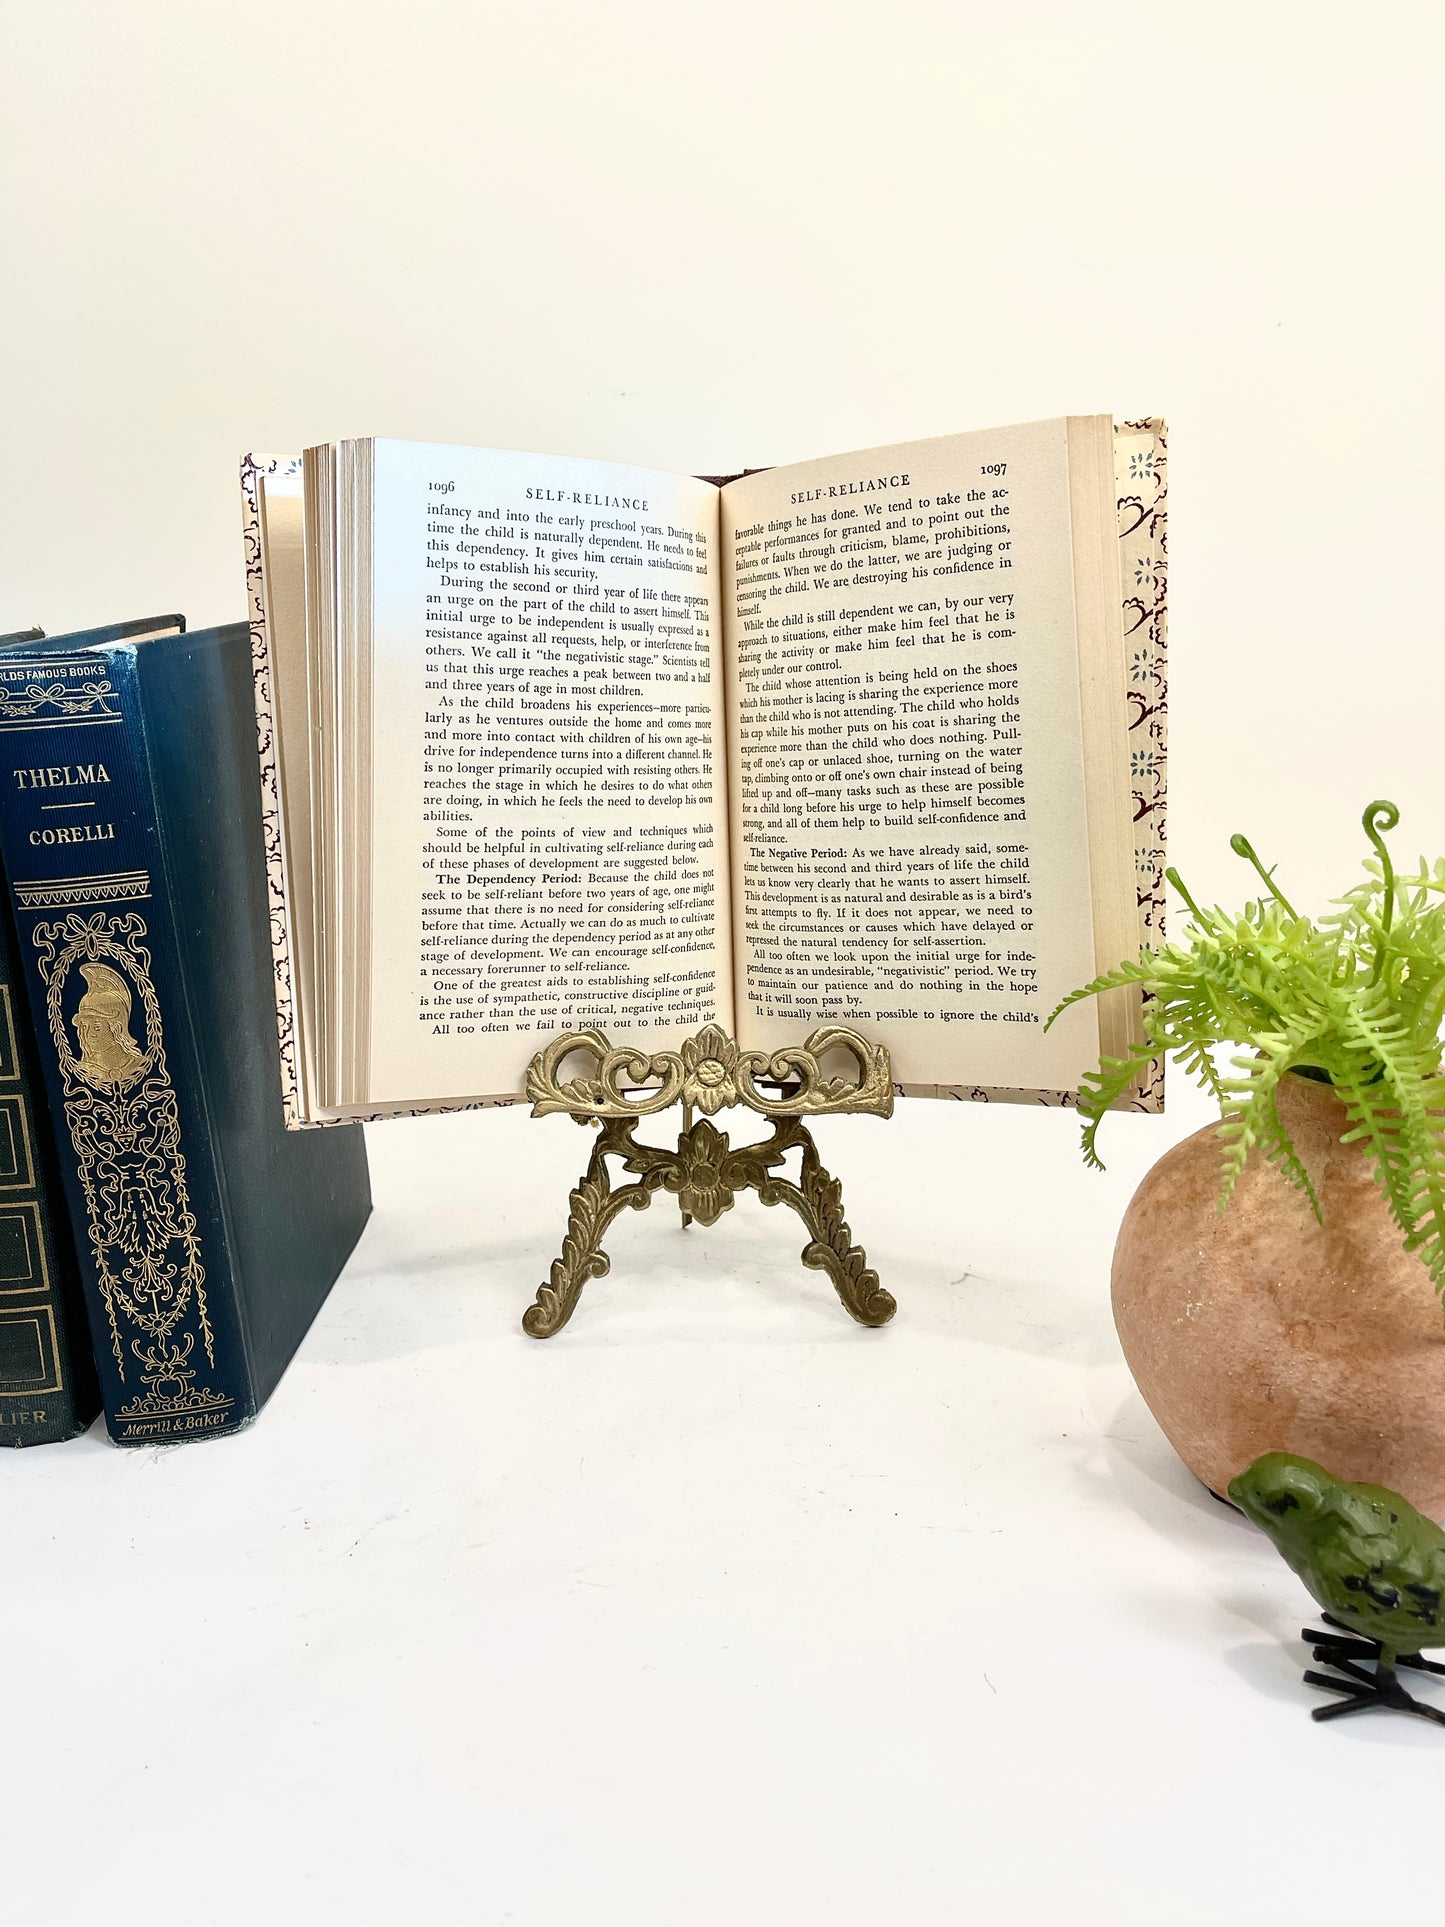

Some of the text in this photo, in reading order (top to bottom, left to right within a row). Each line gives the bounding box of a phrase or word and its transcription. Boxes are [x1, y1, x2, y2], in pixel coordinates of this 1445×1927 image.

[981, 463, 1007, 476] 1097
[429, 481, 455, 494] 1096
[791, 474, 910, 504] SELF-RELIANCE
[525, 488, 649, 511] SELF-RELIANCE
[427, 503, 707, 543] infancy and into the early preschool years. During this
[735, 489, 1009, 540] favorable things he has done. We tend to take the ac-
[426, 556, 598, 582] helps to establish his security.
[736, 556, 1012, 602] censoring the child. We are destroying his confidence in
[440, 575, 709, 607] During the second or third year of life there appears
[743, 594, 1014, 631] While the child is still dependent we can, by our very
[0, 666, 106, 682] RLDS FAMOUS BOOKS
[425, 678, 644, 696] and three years of age in most children.
[13, 763, 111, 789] THELMA
[423, 761, 434, 772] is
[457, 762, 495, 776] longer
[498, 763, 552, 778] primarily
[555, 764, 603, 778] occupied
[606, 764, 630, 775] with
[633, 764, 672, 777] resisting
[674, 764, 700, 774] others.
[702, 764, 713, 774] He
[742, 802, 752, 813] for
[760, 802, 780, 813] child
[783, 803, 803, 816] long
[806, 802, 837, 812] before
[840, 801, 855, 812] his
[858, 803, 882, 814] urge
[886, 802, 898, 810] to
[901, 798, 926, 812] help
[931, 796, 973, 808] himself
[977, 795, 1026, 806] becomes
[29, 824, 115, 846] CORELLI
[436, 823, 714, 841] Some of the points of view and techniques which
[750, 842, 1029, 861] The Negative Period: As we have already said, some-
[435, 869, 716, 887] The Dependency Period: Because the child does not
[420, 941, 716, 964] stage of development. We can encourage self-confidence,
[745, 935, 986, 950] repressed the natural tendency for self-assertion.
[431, 967, 484, 977] necessary
[487, 963, 547, 974] forerunner
[550, 964, 561, 972] to
[564, 961, 630, 971] self-reliance.
[756, 1005, 764, 1016] It
[767, 1006, 774, 1016] is
[777, 1007, 812, 1021] usually
[815, 1006, 838, 1019] wise
[842, 1006, 871, 1019] when
[876, 1008, 918, 1021] possible
[923, 1011, 935, 1019] to
[940, 1009, 975, 1022] ignore
[980, 1010, 998, 1021] the
[122, 1422, 171, 1436] Merrill
[185, 1411, 229, 1429] Baker
